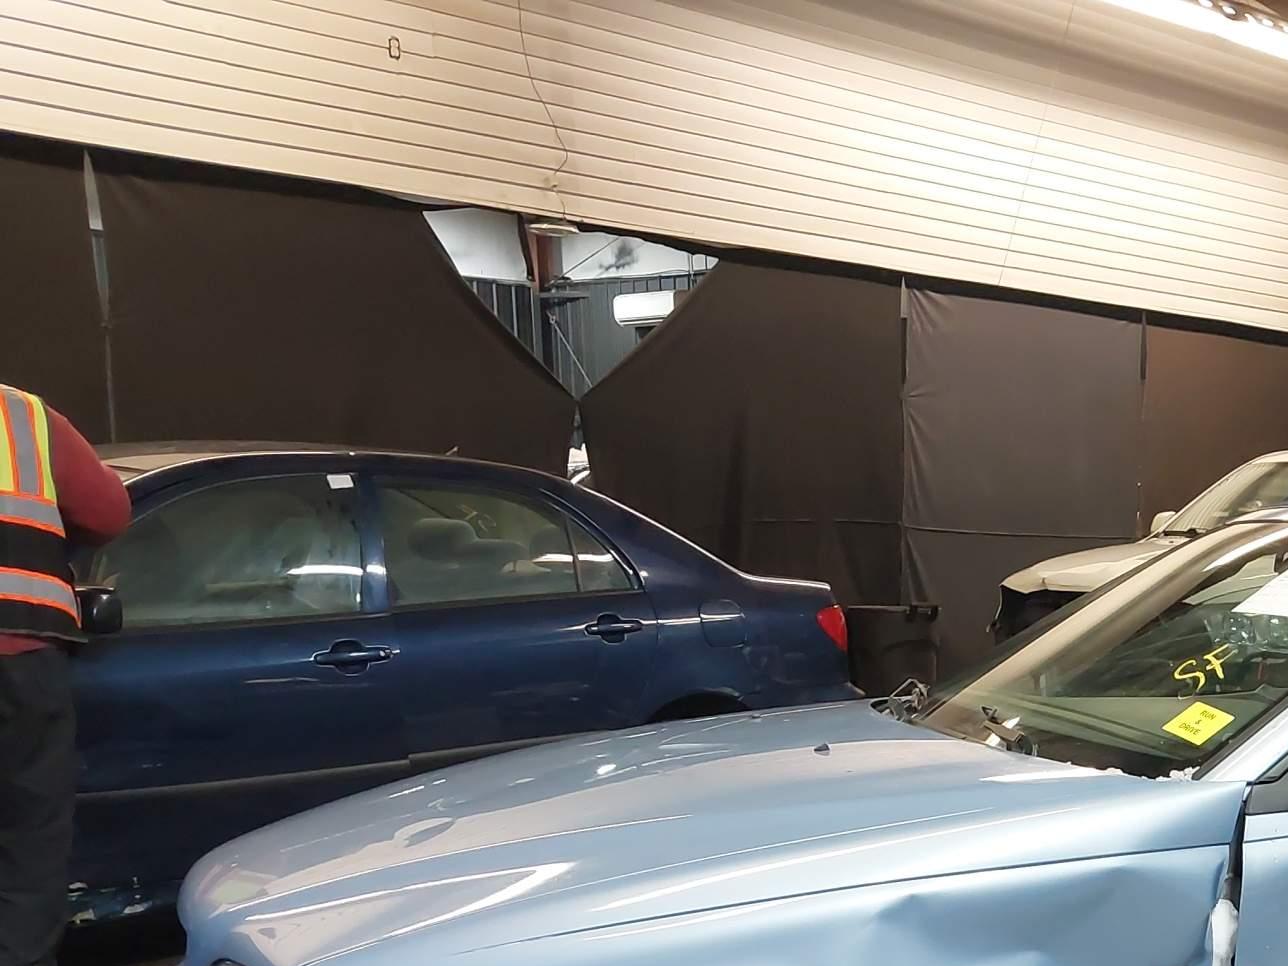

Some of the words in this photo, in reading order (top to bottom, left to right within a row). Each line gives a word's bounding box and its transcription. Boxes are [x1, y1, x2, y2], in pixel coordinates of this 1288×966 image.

[1174, 643, 1239, 698] SF
[1200, 710, 1217, 721] RUN
[1178, 722, 1201, 736] DRIVE
